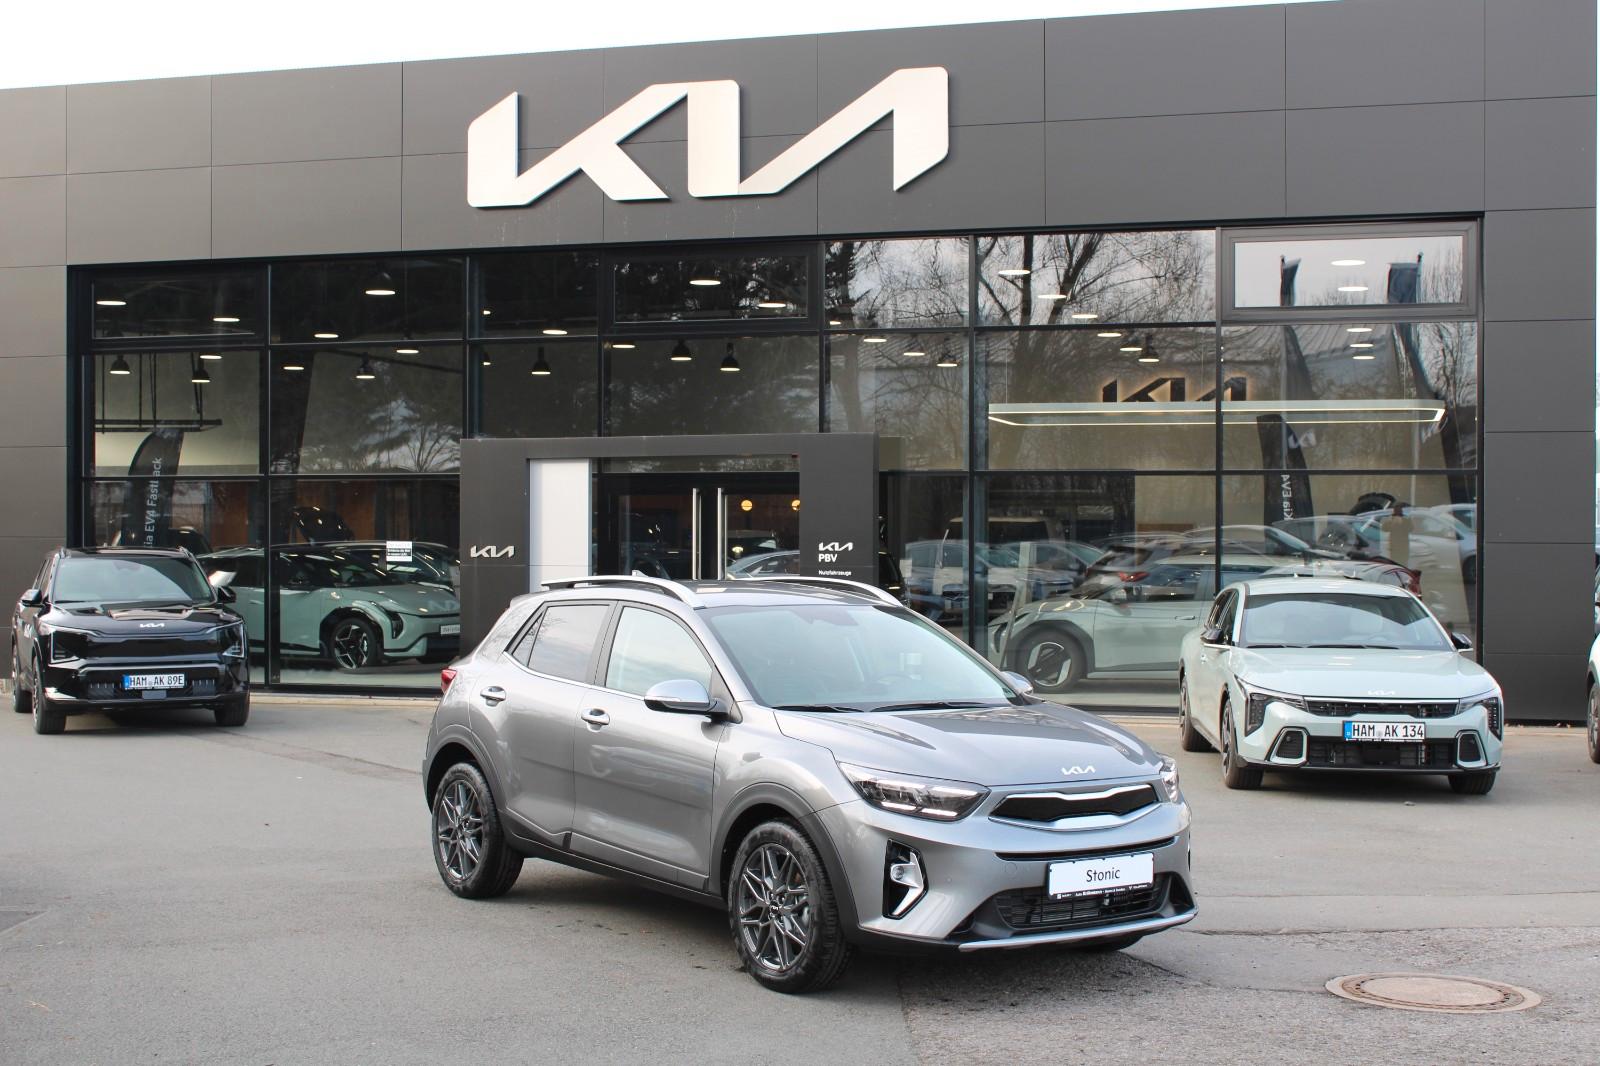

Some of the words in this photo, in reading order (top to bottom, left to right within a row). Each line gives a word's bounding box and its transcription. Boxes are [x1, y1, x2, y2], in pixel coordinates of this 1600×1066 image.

[467, 66, 949, 208] KIA
[470, 545, 515, 558] KIA
[818, 541, 854, 551] KIA
[818, 553, 838, 562] PBV
[130, 675, 147, 686] HAM
[154, 676, 165, 686] AK
[167, 675, 184, 685] 89E
[1352, 724, 1375, 737] HAM
[1384, 724, 1399, 737] AK
[1402, 725, 1424, 738] 134
[1086, 867, 1121, 883] Stonic
